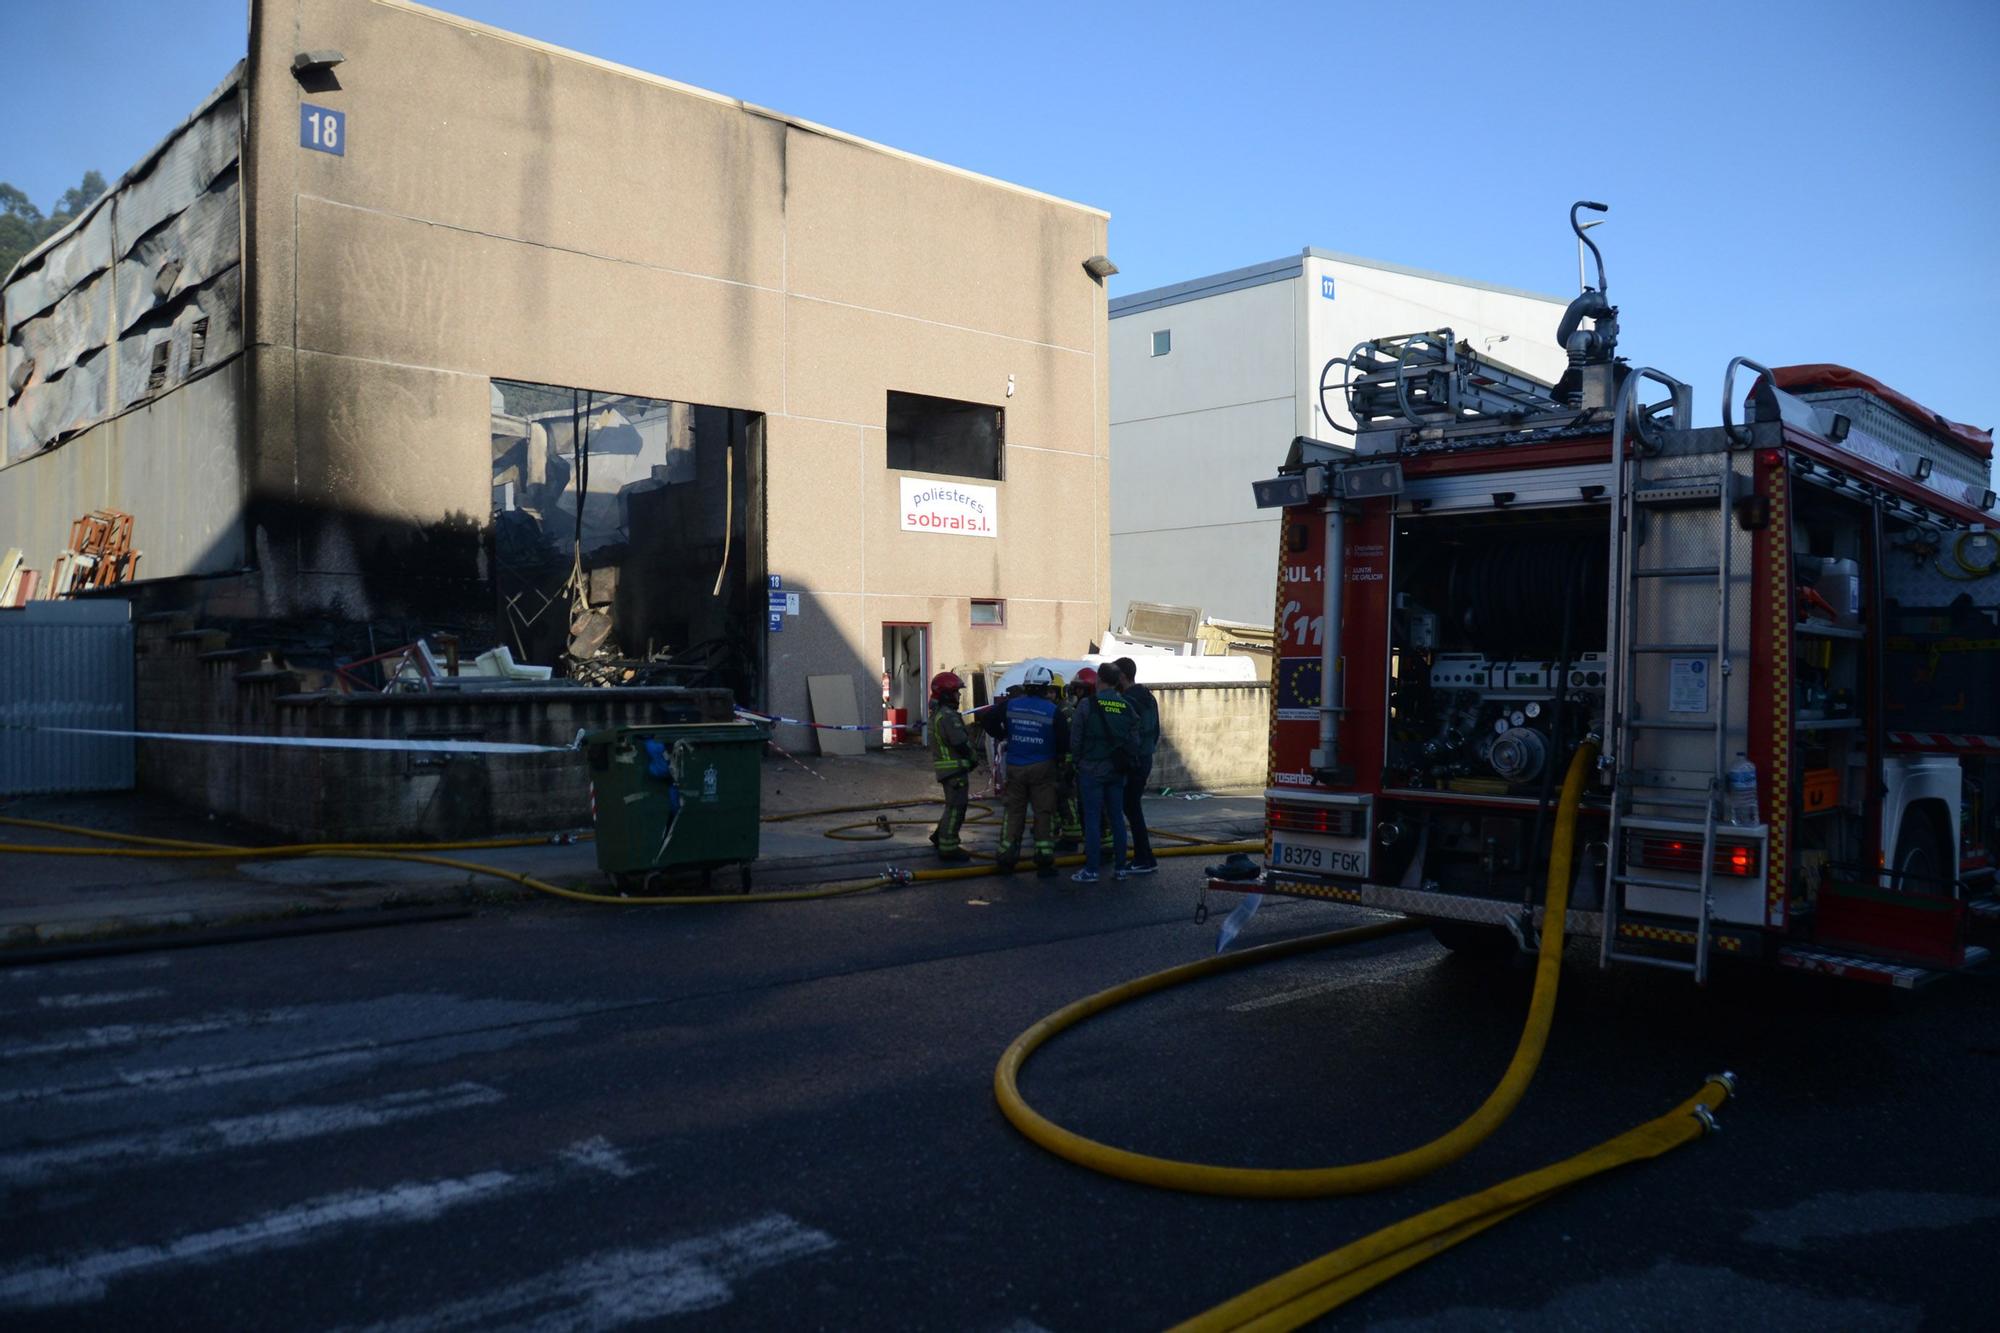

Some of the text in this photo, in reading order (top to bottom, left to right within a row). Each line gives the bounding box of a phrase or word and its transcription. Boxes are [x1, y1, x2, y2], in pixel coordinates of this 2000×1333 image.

[308, 112, 338, 148] 18
[1323, 280, 1333, 295] 17
[913, 487, 984, 514] poliésteres
[907, 511, 991, 531] sobral s.l.
[770, 576, 780, 588] 18
[1097, 699, 1127, 709] GUARDIA
[1104, 706, 1123, 714] CIVIL
[1284, 846, 1361, 873] 8379 FGK
